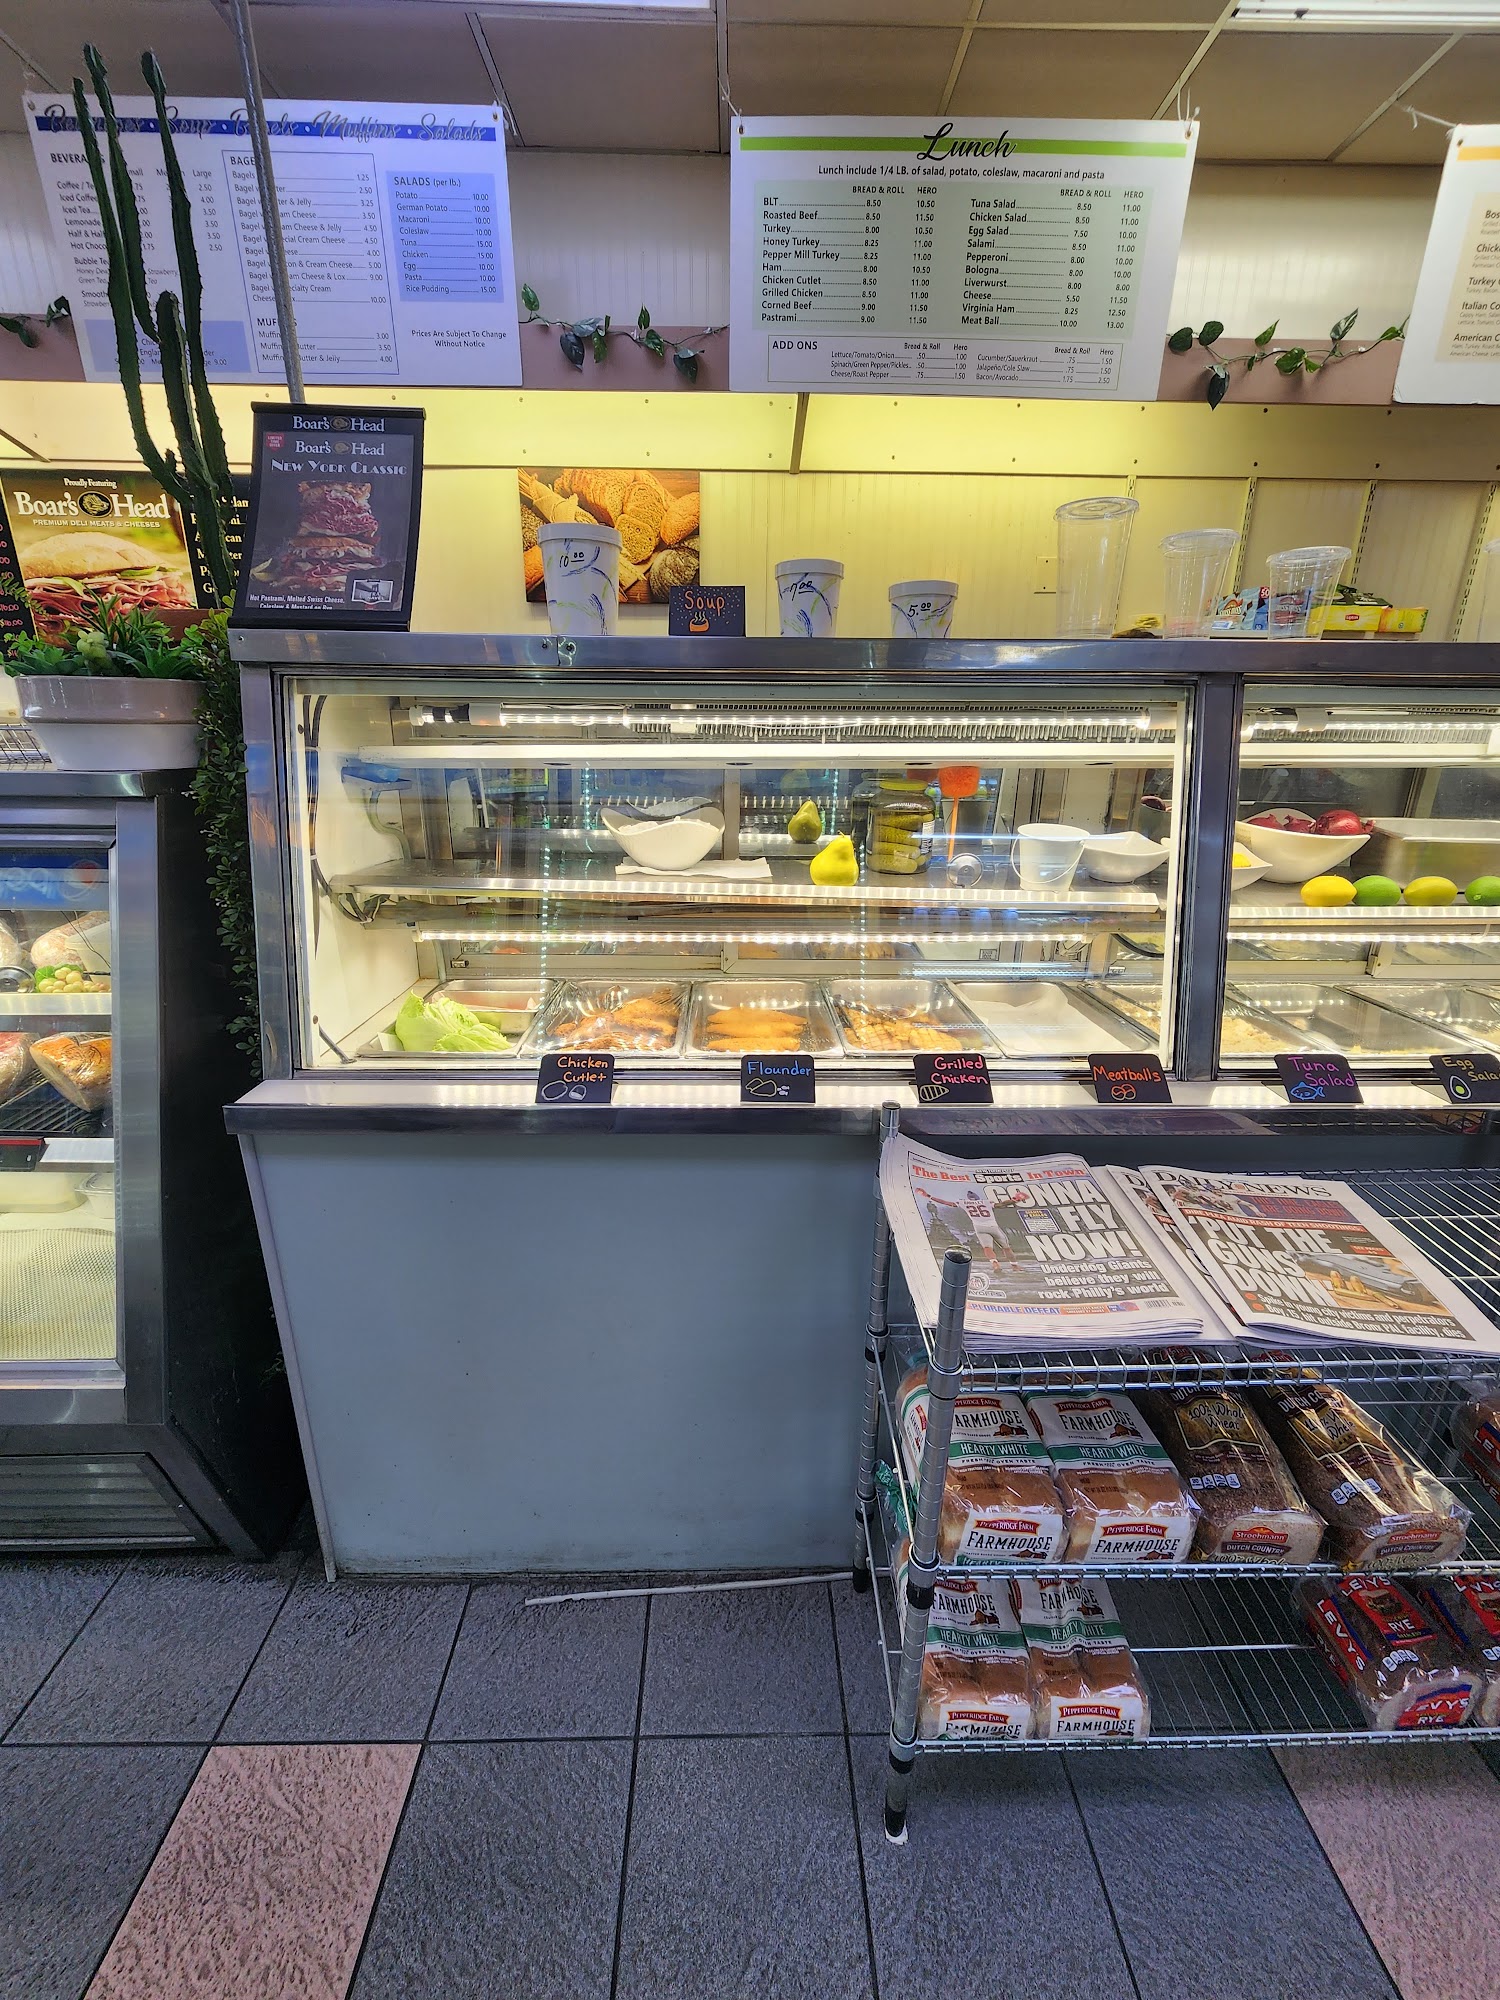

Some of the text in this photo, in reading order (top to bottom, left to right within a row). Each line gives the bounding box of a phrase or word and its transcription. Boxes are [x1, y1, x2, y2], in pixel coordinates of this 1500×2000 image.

[314, 111, 487, 144] Muffins Salads
[916, 122, 1017, 161] Lunch
[819, 165, 1104, 181] Lunch include 1/4 LB. of salad, potato, coleslaw, macaroni and pasta
[394, 177, 460, 187] SALADS (per lb.)
[1060, 189, 1084, 197] BREAD
[1094, 190, 1111, 198] ROLL
[764, 198, 778, 206] BLT
[971, 199, 1015, 208] Tuna Salad
[763, 211, 818, 219] Roasted Beef
[970, 213, 1027, 222] Chicken Salad
[764, 224, 791, 234] Turkey
[968, 226, 1009, 236] Egg Salad
[763, 237, 820, 248] Honey Turkey
[968, 239, 995, 248] Salami
[763, 251, 840, 260] Pepper Mill Turkey
[966, 252, 1008, 263] Pepperoni
[404, 262, 416, 270] Egg
[763, 263, 782, 271] Ham
[966, 265, 999, 276] Bologna
[762, 276, 821, 284] Chicken Cutlet
[965, 278, 1007, 287] Liverwurst
[1469, 277, 1496, 287] Turkey
[422, 285, 449, 294] Pudding
[762, 288, 823, 297] Grilled Chicken
[964, 291, 991, 299] Cheese
[762, 301, 812, 310] Corned Beef
[962, 303, 1014, 314] Virginia Ham
[1462, 302, 1487, 310] Italian
[762, 314, 797, 322] Pastrami
[962, 316, 999, 325] Meat Ball
[1454, 334, 1492, 342] American
[772, 340, 817, 350] ADD ONS
[293, 416, 385, 432] Boar's Head
[296, 440, 331, 454] Boar's
[351, 442, 384, 455] Head
[271, 459, 407, 475] NEW YORK CLASSIC
[63, 477, 117, 489] Proudly Featuring
[14, 491, 171, 518] Boar's Head
[33, 519, 68, 527] PREMIUM
[684, 591, 725, 615] Soup
[556, 1056, 610, 1069] Chicken
[747, 1060, 813, 1077] Flounder
[934, 1056, 984, 1070] Grilled
[1288, 1057, 1339, 1072] Tuna
[1442, 1057, 1475, 1070] Egg
[563, 1071, 607, 1084] Cutlet
[931, 1072, 987, 1085] Chicken
[1093, 1065, 1161, 1083] Meatballs
[1305, 1071, 1355, 1087] Salad
[912, 1165, 1086, 1183] The Best Sports In Town
[1152, 1170, 1332, 1198] DAILY NEWS
[984, 1179, 1109, 1208] GONNA
[966, 1205, 991, 1218] 26
[1057, 1204, 1119, 1231] FLY
[1025, 1230, 1143, 1262] NOW!
[1265, 1228, 1343, 1253] THE
[1209, 1237, 1306, 1278] GUNS
[1040, 1259, 1152, 1275] Underdog Giants
[1044, 1271, 1162, 1287] believe they will
[1037, 1282, 1170, 1299] rock Philly's world
[1059, 1409, 1137, 1432] FARMHOUSE
[961, 1443, 1028, 1456] HEARTY WHITE
[1079, 1444, 1147, 1458] HEARTY WHITE
[980, 1521, 1034, 1531] PEPPERIDGE FARM
[1106, 1525, 1163, 1535] PEPPERIDGE FARM
[967, 1530, 1053, 1550] FARMHOUSE
[1236, 1531, 1286, 1541] Stroehmann
[1095, 1538, 1180, 1553] FARMHOUSE
[1252, 1545, 1285, 1554] COUNTRY
[1389, 1618, 1416, 1632] RYE
